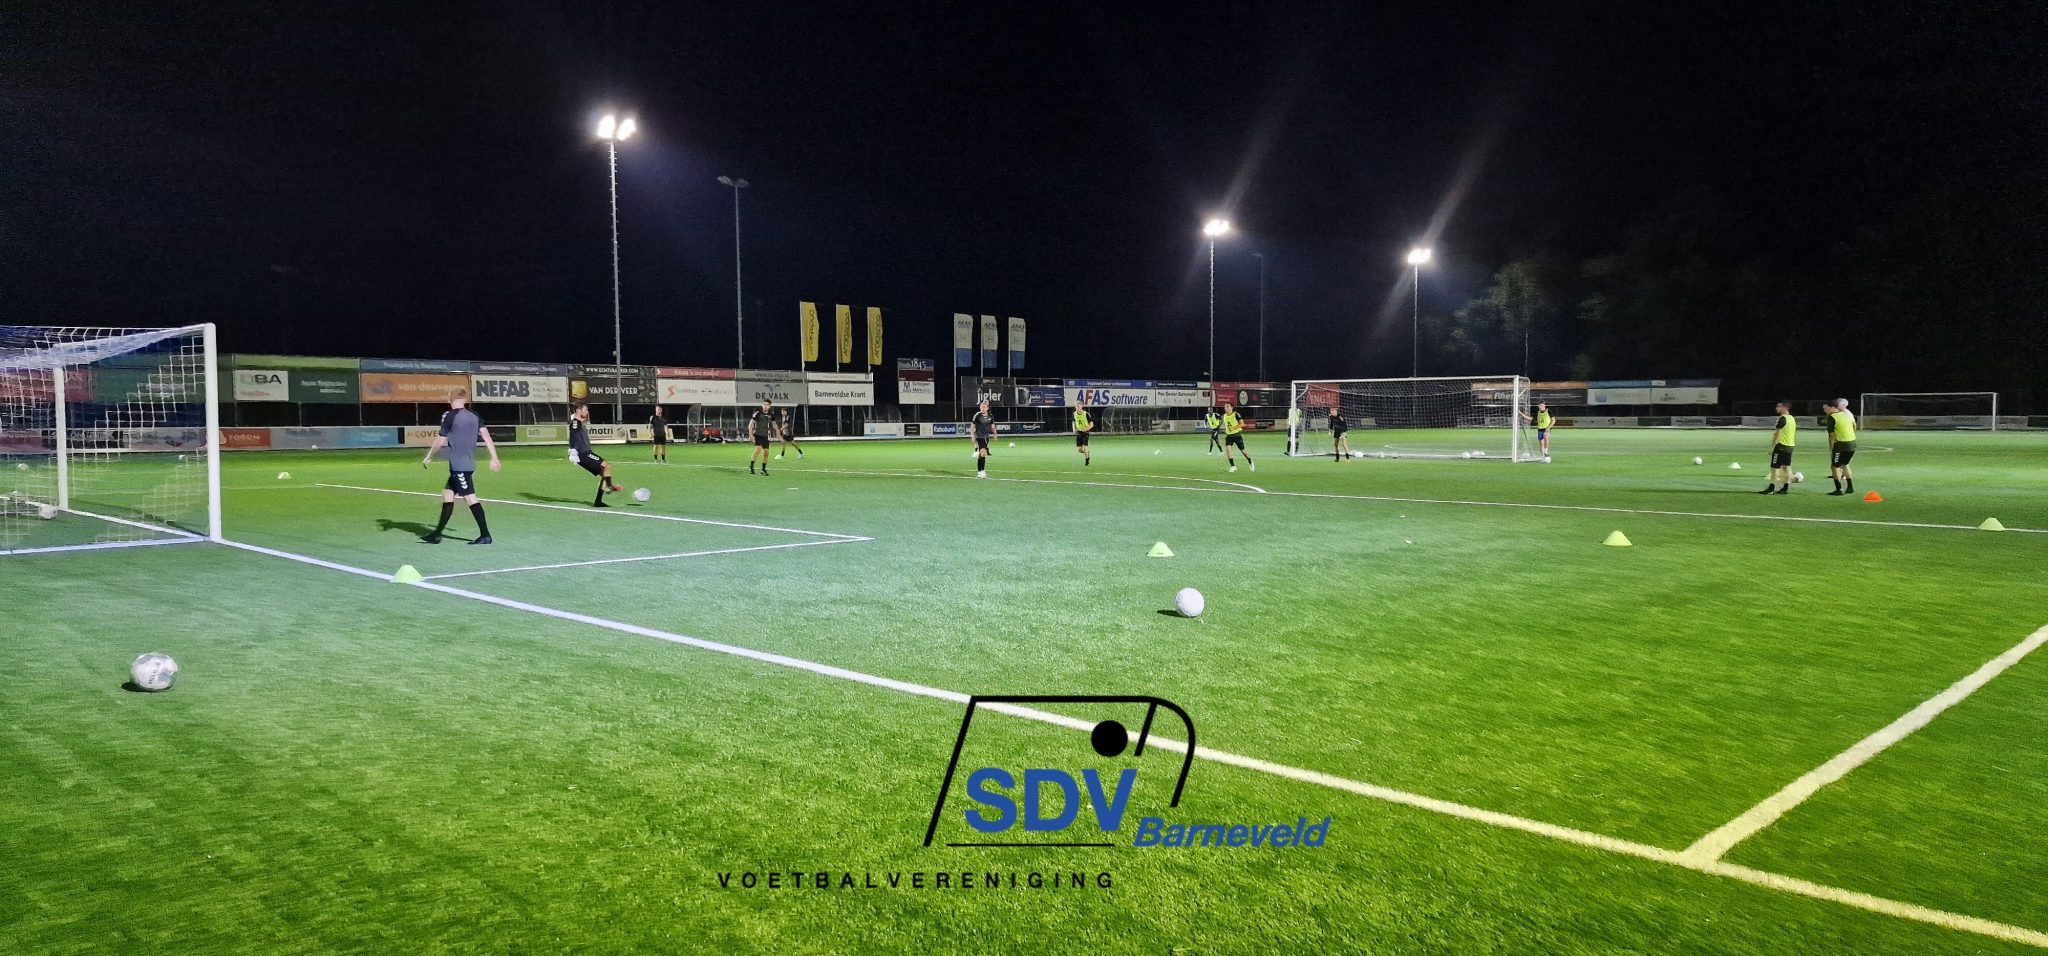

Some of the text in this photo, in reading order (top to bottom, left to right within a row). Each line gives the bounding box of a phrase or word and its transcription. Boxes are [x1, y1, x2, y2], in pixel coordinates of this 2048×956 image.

[911, 358, 927, 370] 1845
[475, 380, 530, 398] NEFAB
[620, 387, 638, 395] VEER
[767, 392, 789, 400] VALK
[814, 390, 849, 398] Barneveldse
[976, 387, 1002, 405] jigler
[1076, 390, 1148, 405] AFAS software
[586, 426, 613, 435] motri
[933, 424, 956, 433] Rabobank
